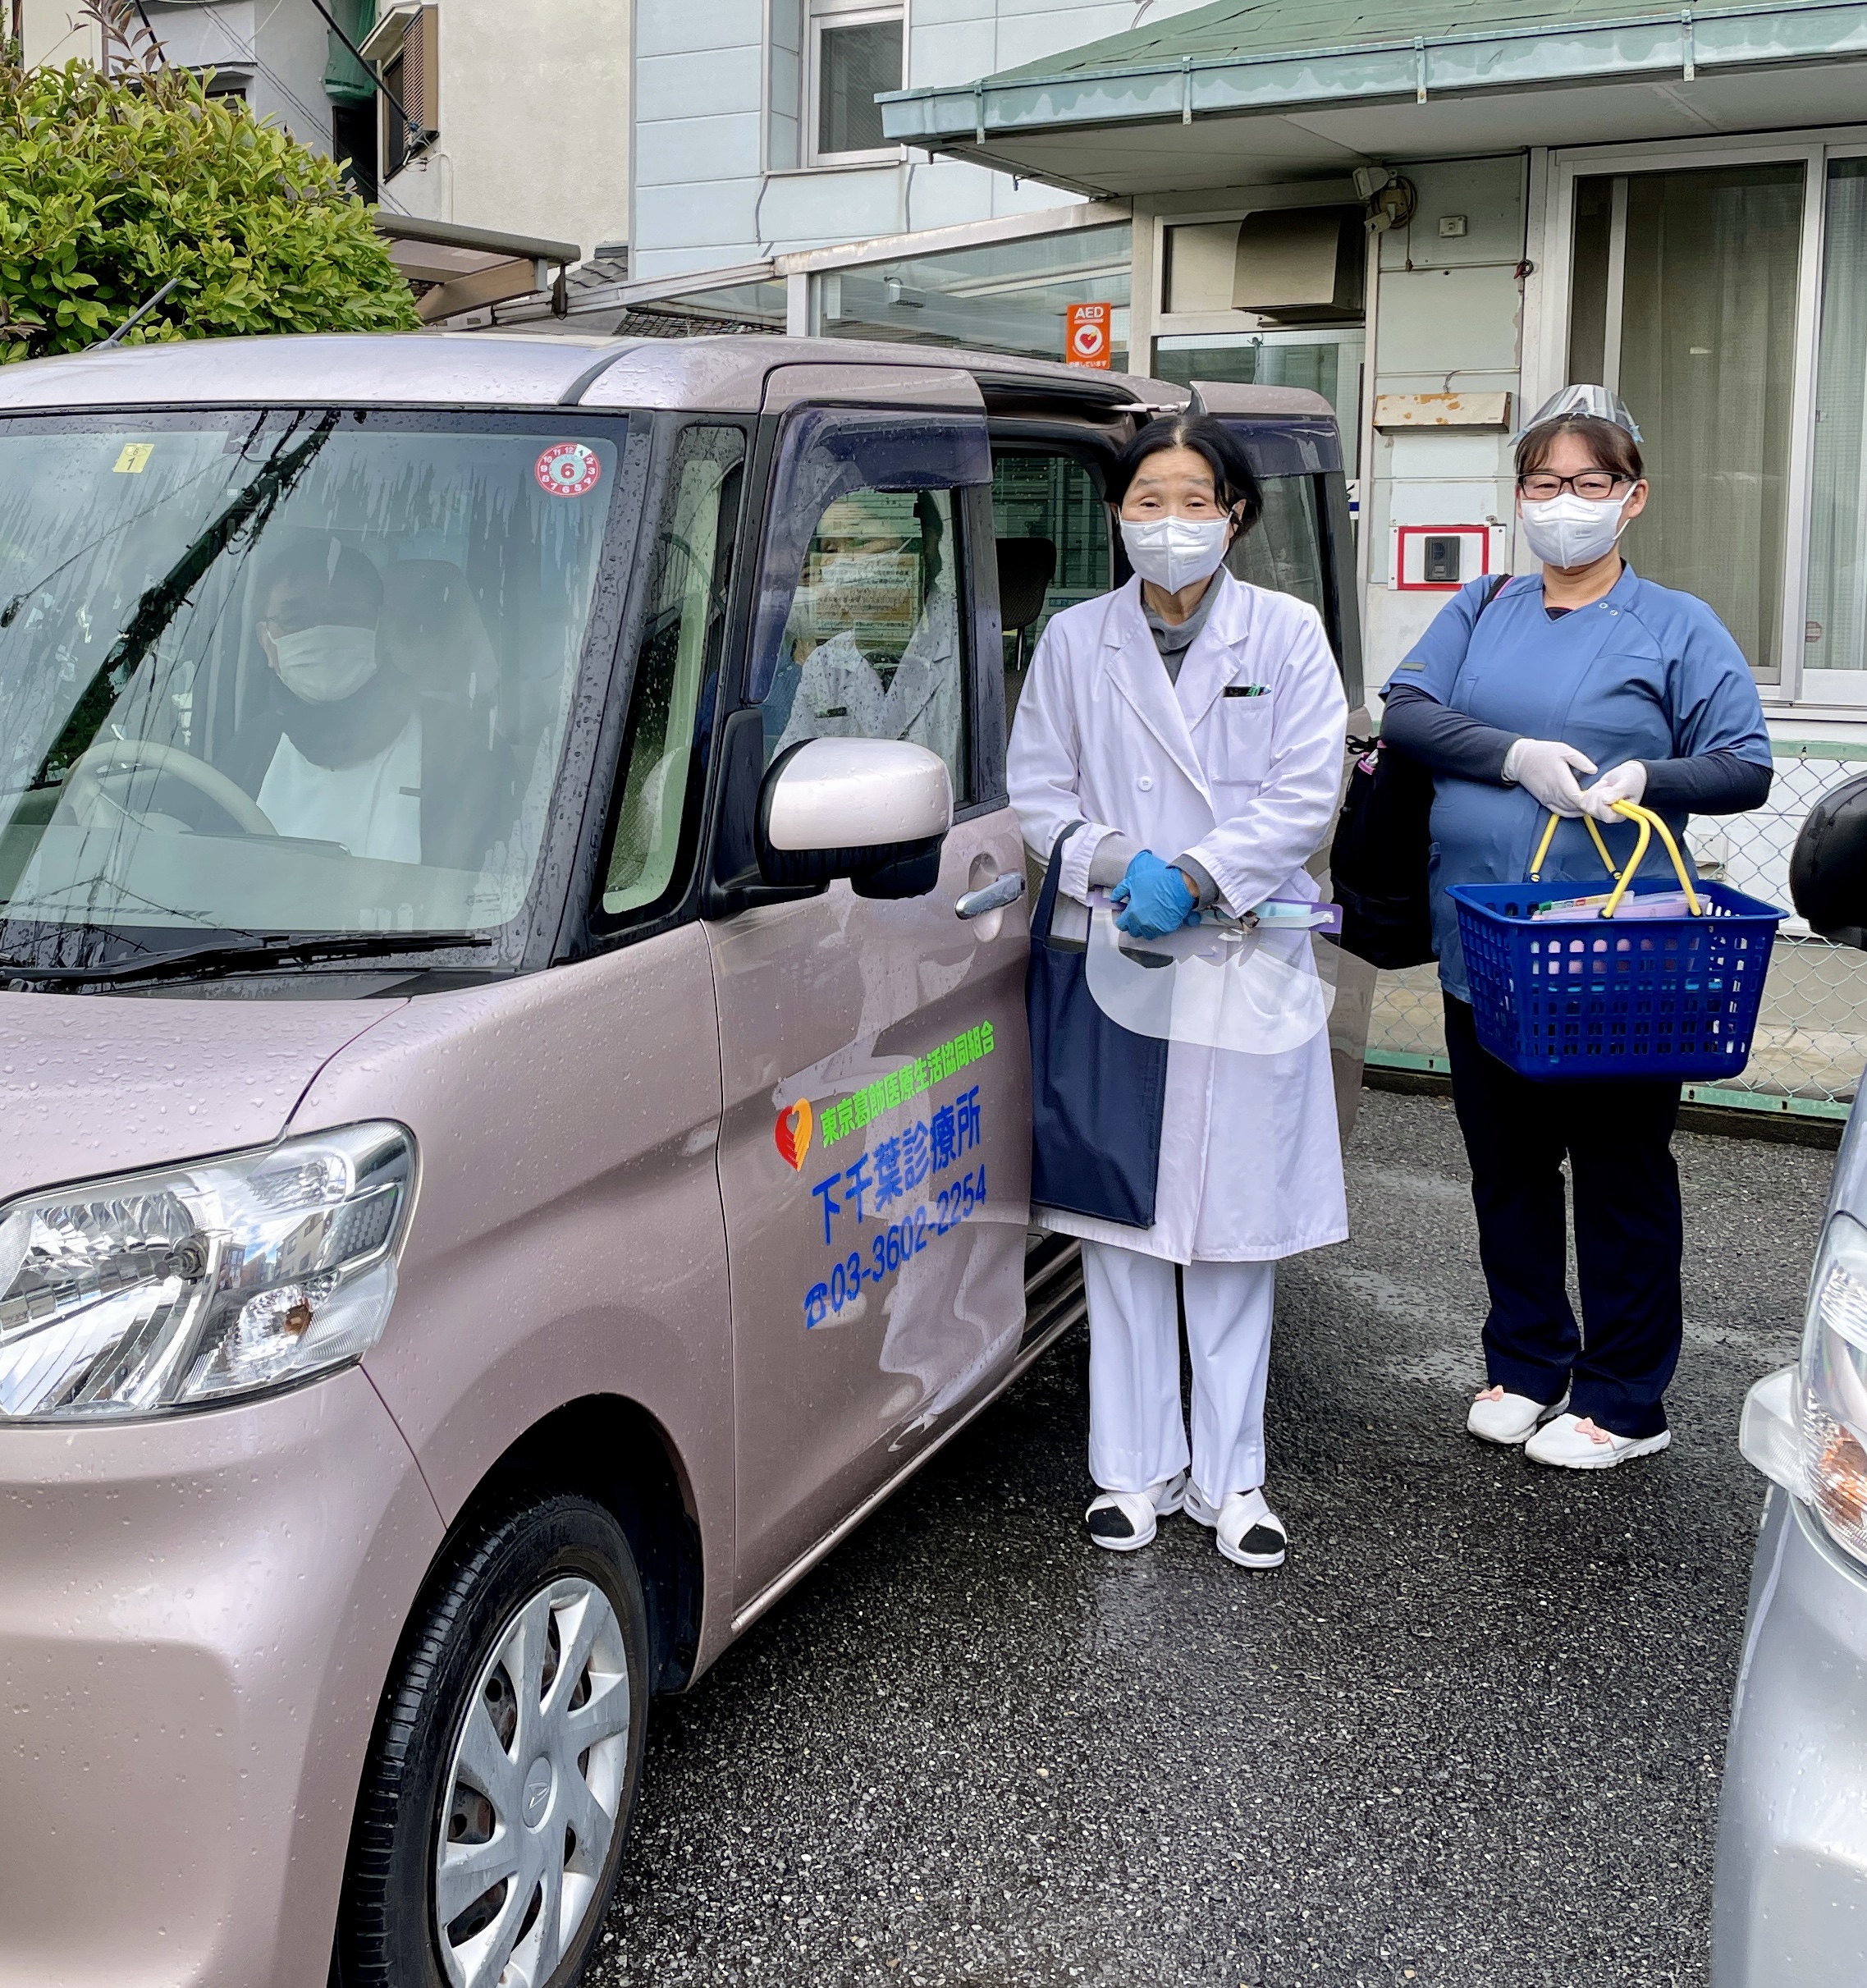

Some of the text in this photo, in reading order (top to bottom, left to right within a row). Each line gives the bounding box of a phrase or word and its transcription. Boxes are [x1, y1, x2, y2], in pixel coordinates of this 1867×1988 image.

[1074, 306, 1104, 318] AED
[127, 457, 135, 470] 1
[561, 463, 574, 479] 6
[821, 1020, 995, 1148] 東京葛飾医療生活協同組合
[812, 1084, 982, 1246] 下千葉診療所
[831, 1163, 986, 1312] 03-3602-2254
